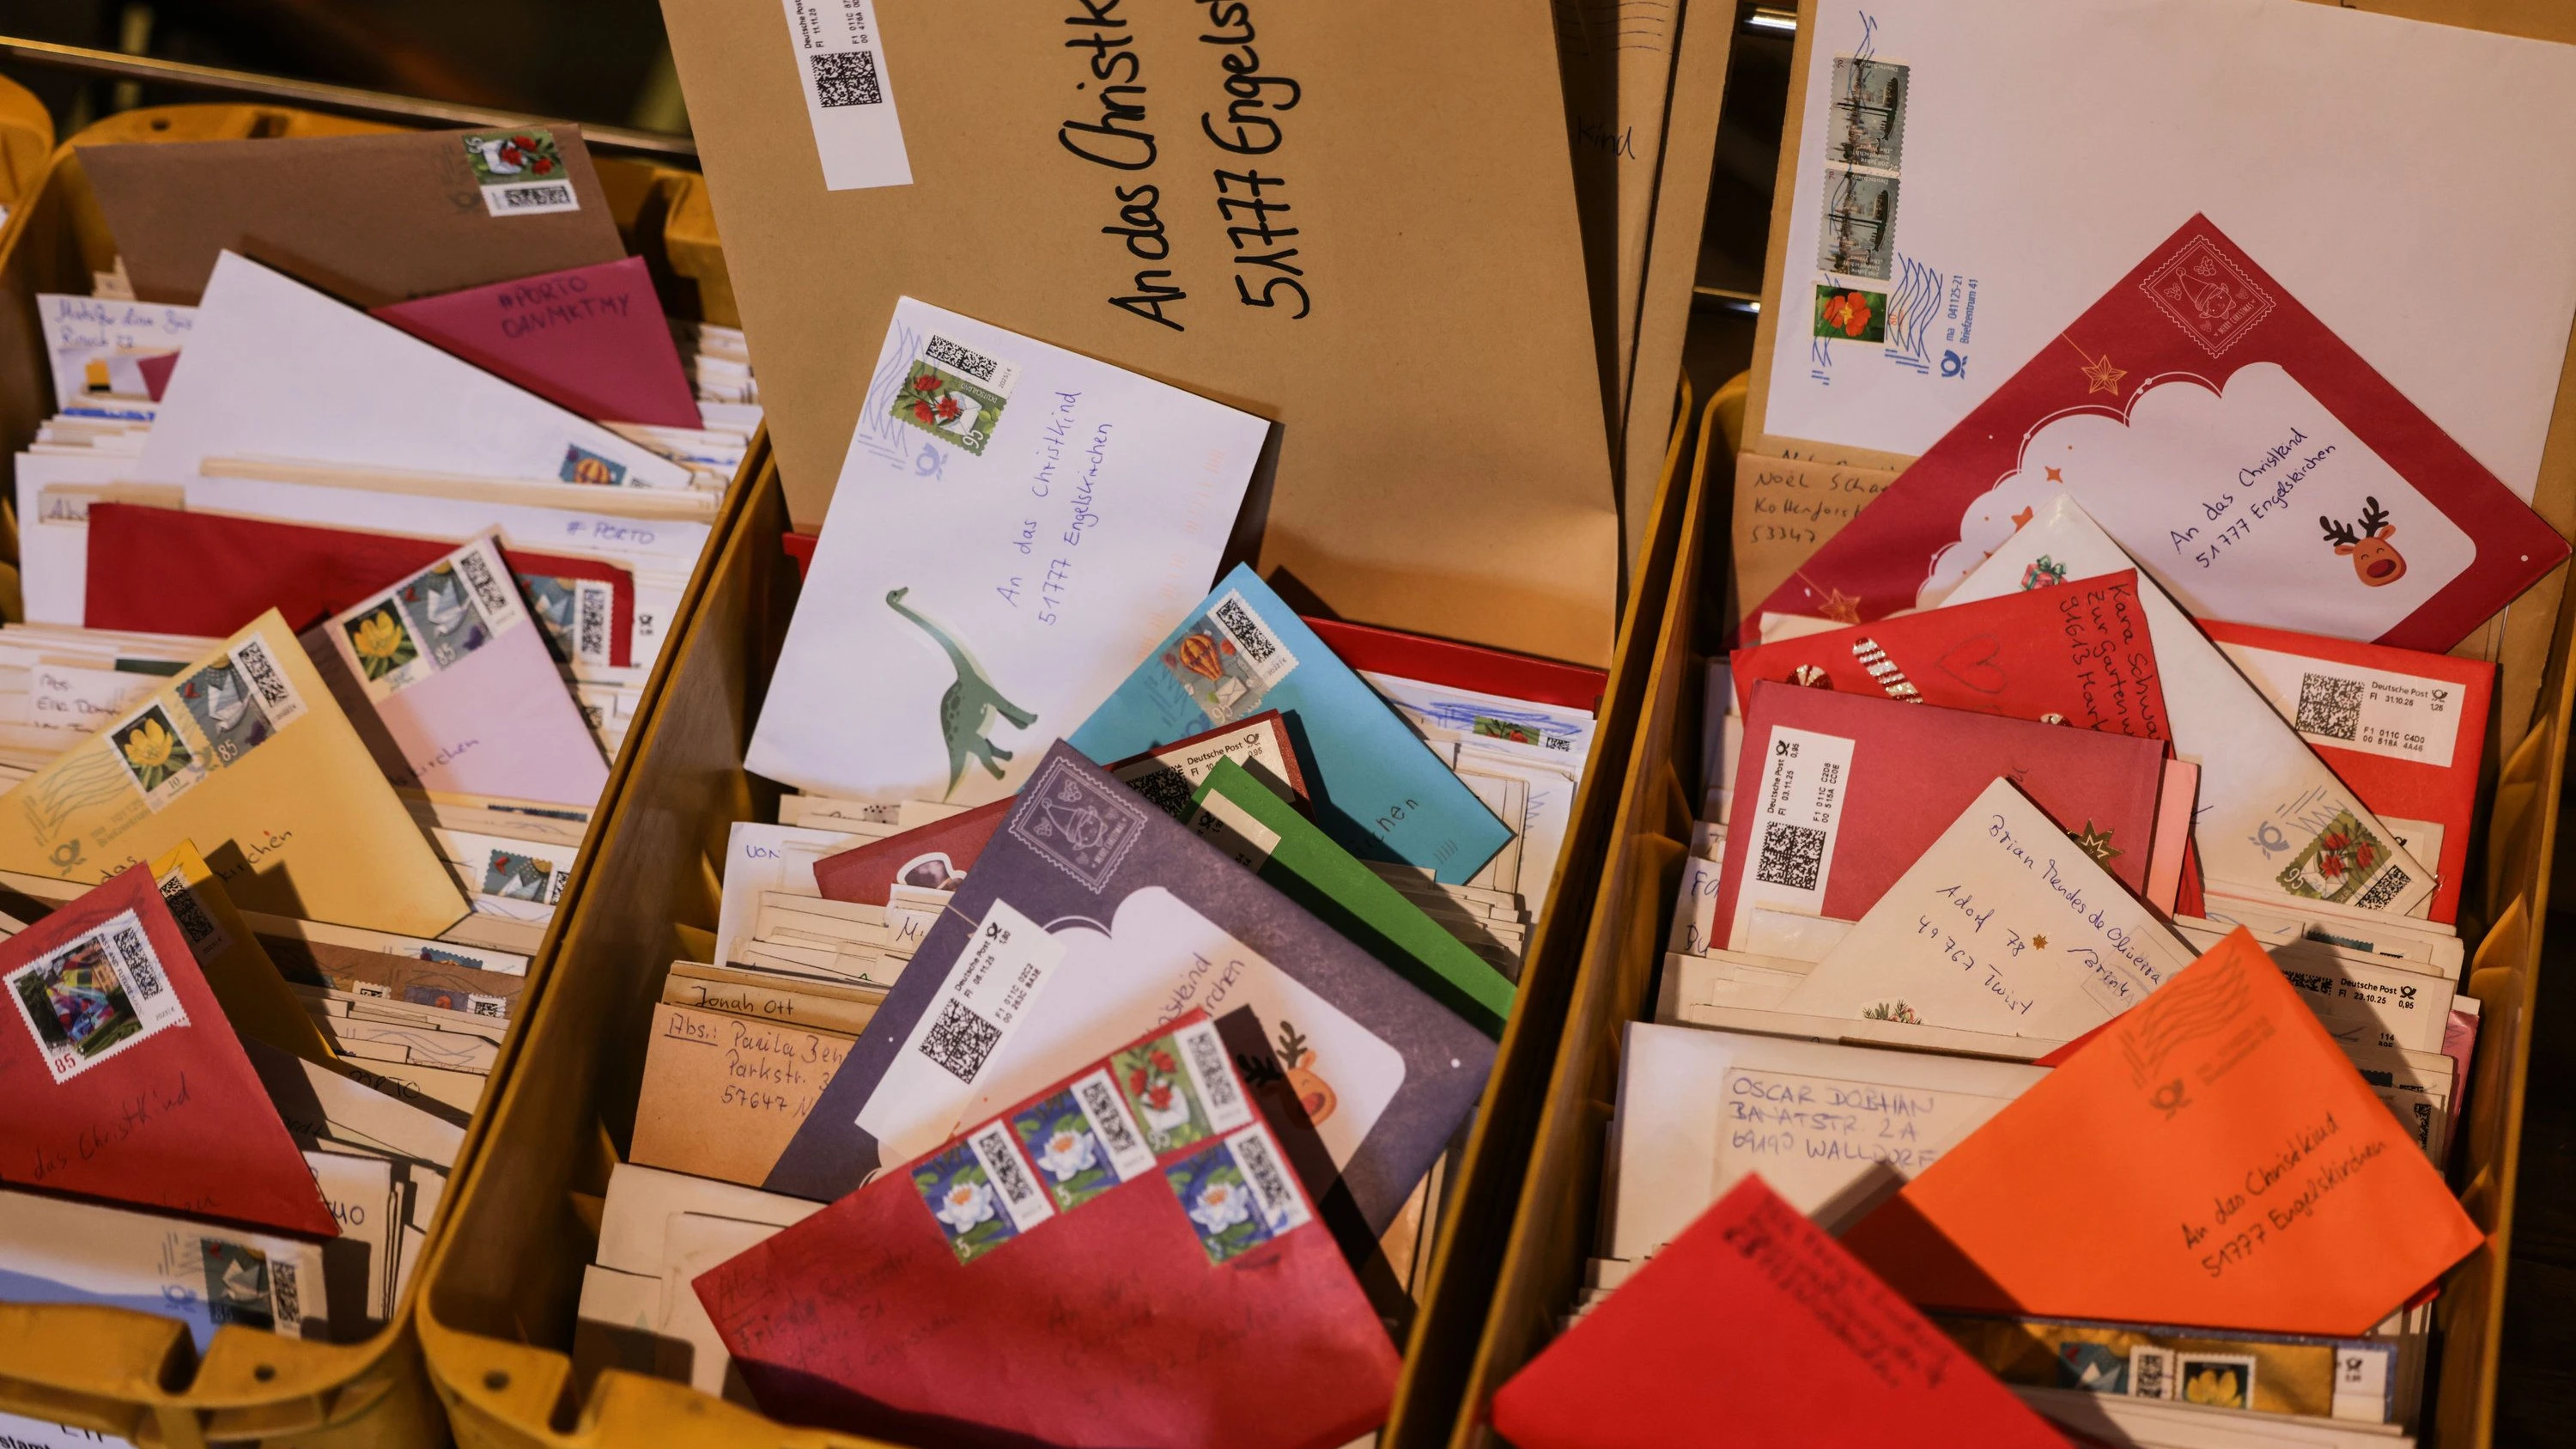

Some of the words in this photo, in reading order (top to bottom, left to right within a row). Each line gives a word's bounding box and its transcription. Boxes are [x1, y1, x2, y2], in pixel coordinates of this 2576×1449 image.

[800, 16, 812, 49] Deutsche
[1194, 0, 1302, 155] Engels
[1101, 184, 1170, 260] das
[1213, 169, 1310, 320] 51777
[1947, 275, 1964, 320] 041125-21
[1968, 278, 1978, 290] 41
[1108, 270, 1187, 332] An
[1959, 290, 1978, 344] Briefzentrum
[960, 383, 999, 405] DEUTSCHLAND
[963, 429, 985, 449] 95
[2170, 527, 2200, 555] An
[2202, 494, 2233, 521] das
[2239, 426, 2308, 488] Christkind
[2195, 518, 2251, 569] 51777
[2250, 444, 2336, 520] Engelskirchen
[1038, 558, 1072, 626] 51777
[1063, 422, 1114, 547] Engelskirchen
[996, 576, 1023, 608] An
[1013, 520, 1037, 556] das
[2060, 595, 2091, 666] 91613
[434, 642, 458, 668] 85
[2108, 583, 2134, 645] Kara
[2127, 653, 2162, 740] Schwa
[2372, 681, 2409, 695] Deutsche
[2410, 688, 2428, 698] Post
[2379, 729, 2400, 740] 011C
[217, 740, 239, 764] 85
[1187, 747, 1224, 766] Deutsche
[1224, 742, 1243, 754] Post
[1248, 747, 1263, 758] 0,95
[1790, 743, 1800, 758] 0,95
[1767, 777, 1781, 814] Deutsche
[1775, 758, 1785, 776] Post
[1781, 770, 1795, 801] 03.11.25
[1815, 787, 1826, 807] 011C
[1374, 799, 1419, 843] hen
[1777, 807, 1787, 816] FI
[1813, 812, 1821, 822] F1
[1821, 813, 1830, 824] 00
[216, 827, 294, 885] kirchen
[1989, 814, 2034, 870] Brian
[2088, 909, 2105, 930] de
[2284, 867, 2306, 890] 95
[896, 916, 925, 942] M
[2007, 928, 2026, 957] 78
[98, 933, 112, 950] PAST
[106, 950, 119, 970] AND
[954, 958, 980, 992] Deutsche
[976, 941, 991, 958] Post
[690, 985, 755, 1013] Jonah
[763, 999, 794, 1016] Ott
[1004, 984, 1020, 1005] 011C
[1984, 964, 2034, 1015] Twist
[2338, 989, 2347, 998] FI
[2354, 991, 2387, 1005] 23.10.25
[2398, 1000, 2415, 1009] 0,95
[2341, 978, 2379, 991] Deutsche
[2379, 984, 2397, 995] Post
[53, 1052, 77, 1075] 85
[720, 1085, 788, 1113] 57647
[1732, 1077, 1816, 1105] OSCAR
[33, 1147, 69, 1181] das
[2201, 1221, 2266, 1279] 51777
[2267, 1141, 2387, 1231] Engelskirchen
[955, 1236, 972, 1258] 5
[2181, 1221, 2209, 1251] An
